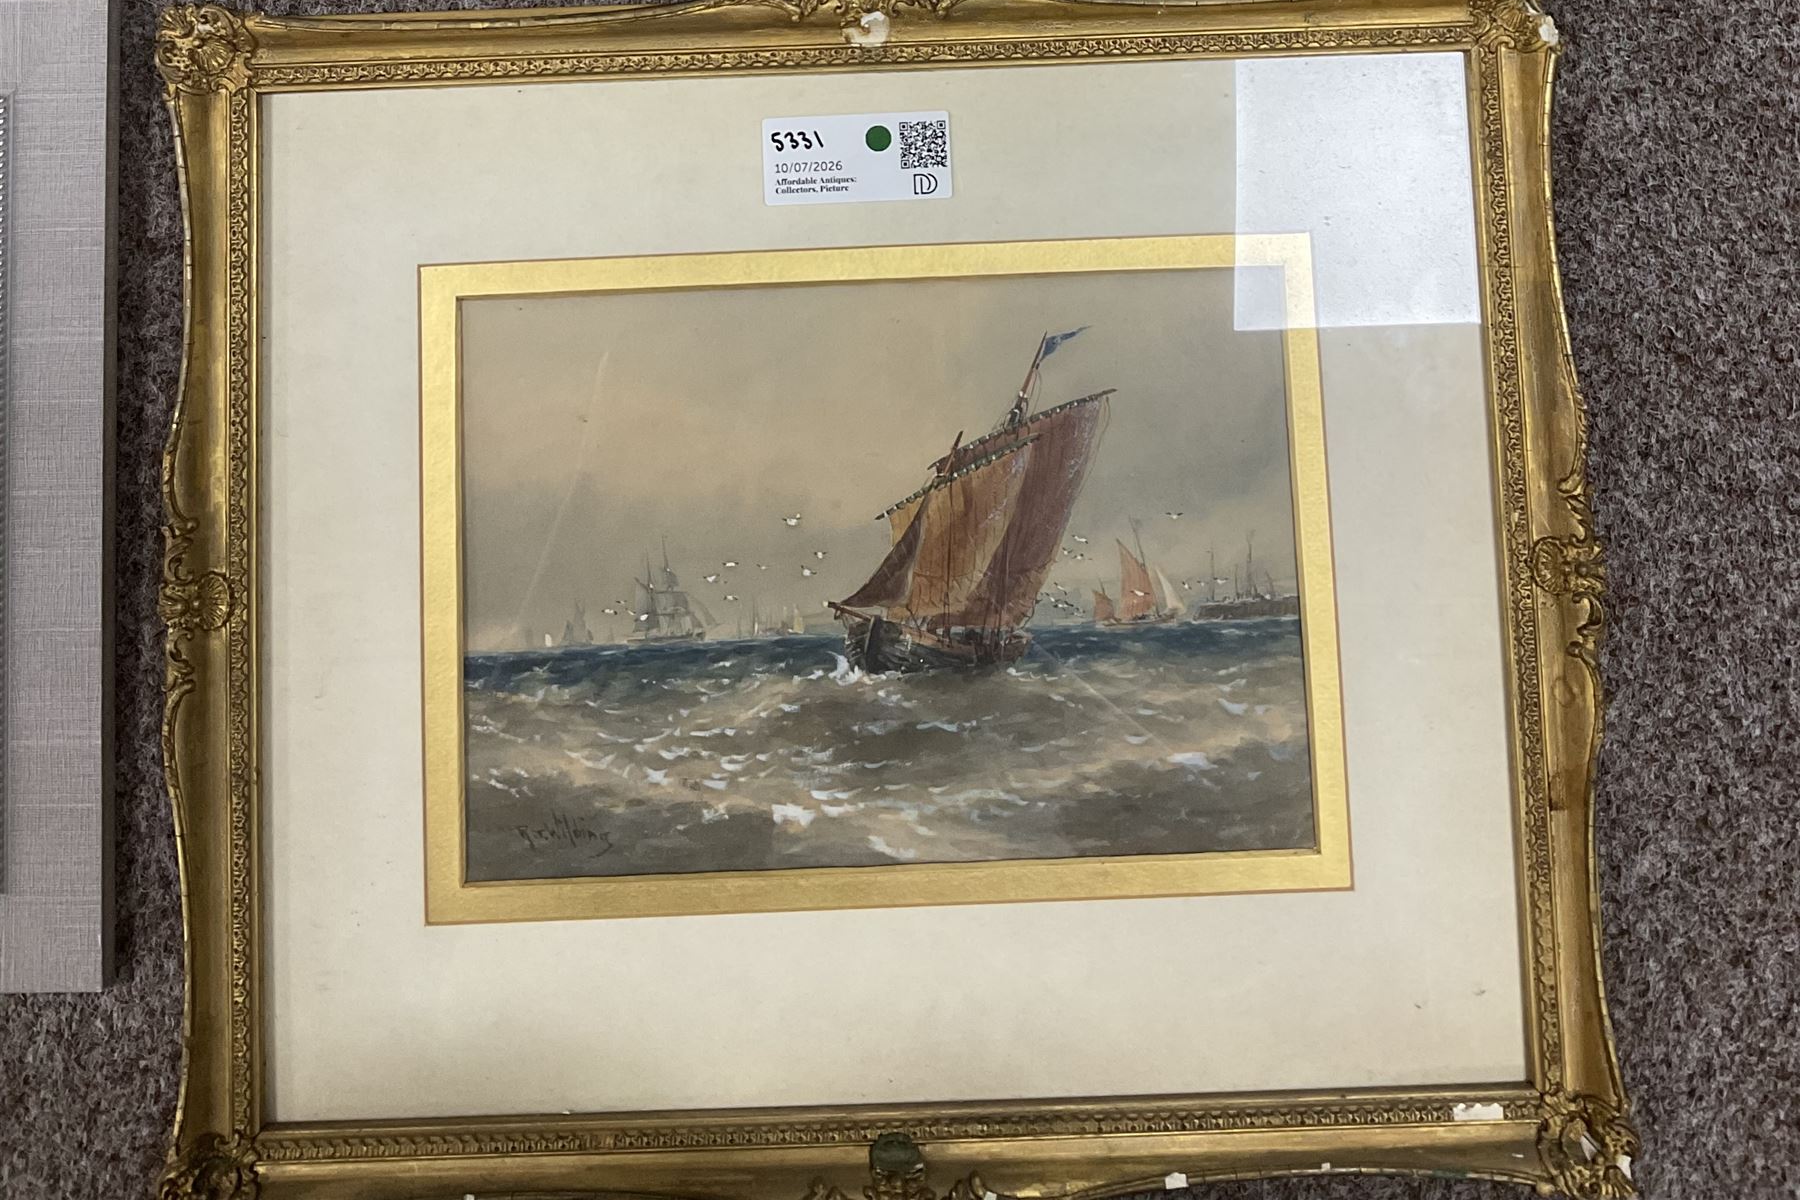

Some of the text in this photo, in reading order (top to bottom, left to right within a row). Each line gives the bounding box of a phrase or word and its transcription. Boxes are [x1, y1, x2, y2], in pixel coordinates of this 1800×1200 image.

[771, 130, 824, 152] 5331
[775, 161, 843, 173] 10/07/2026
[775, 178, 818, 186] Affordable
[775, 186, 818, 194] Collectors,
